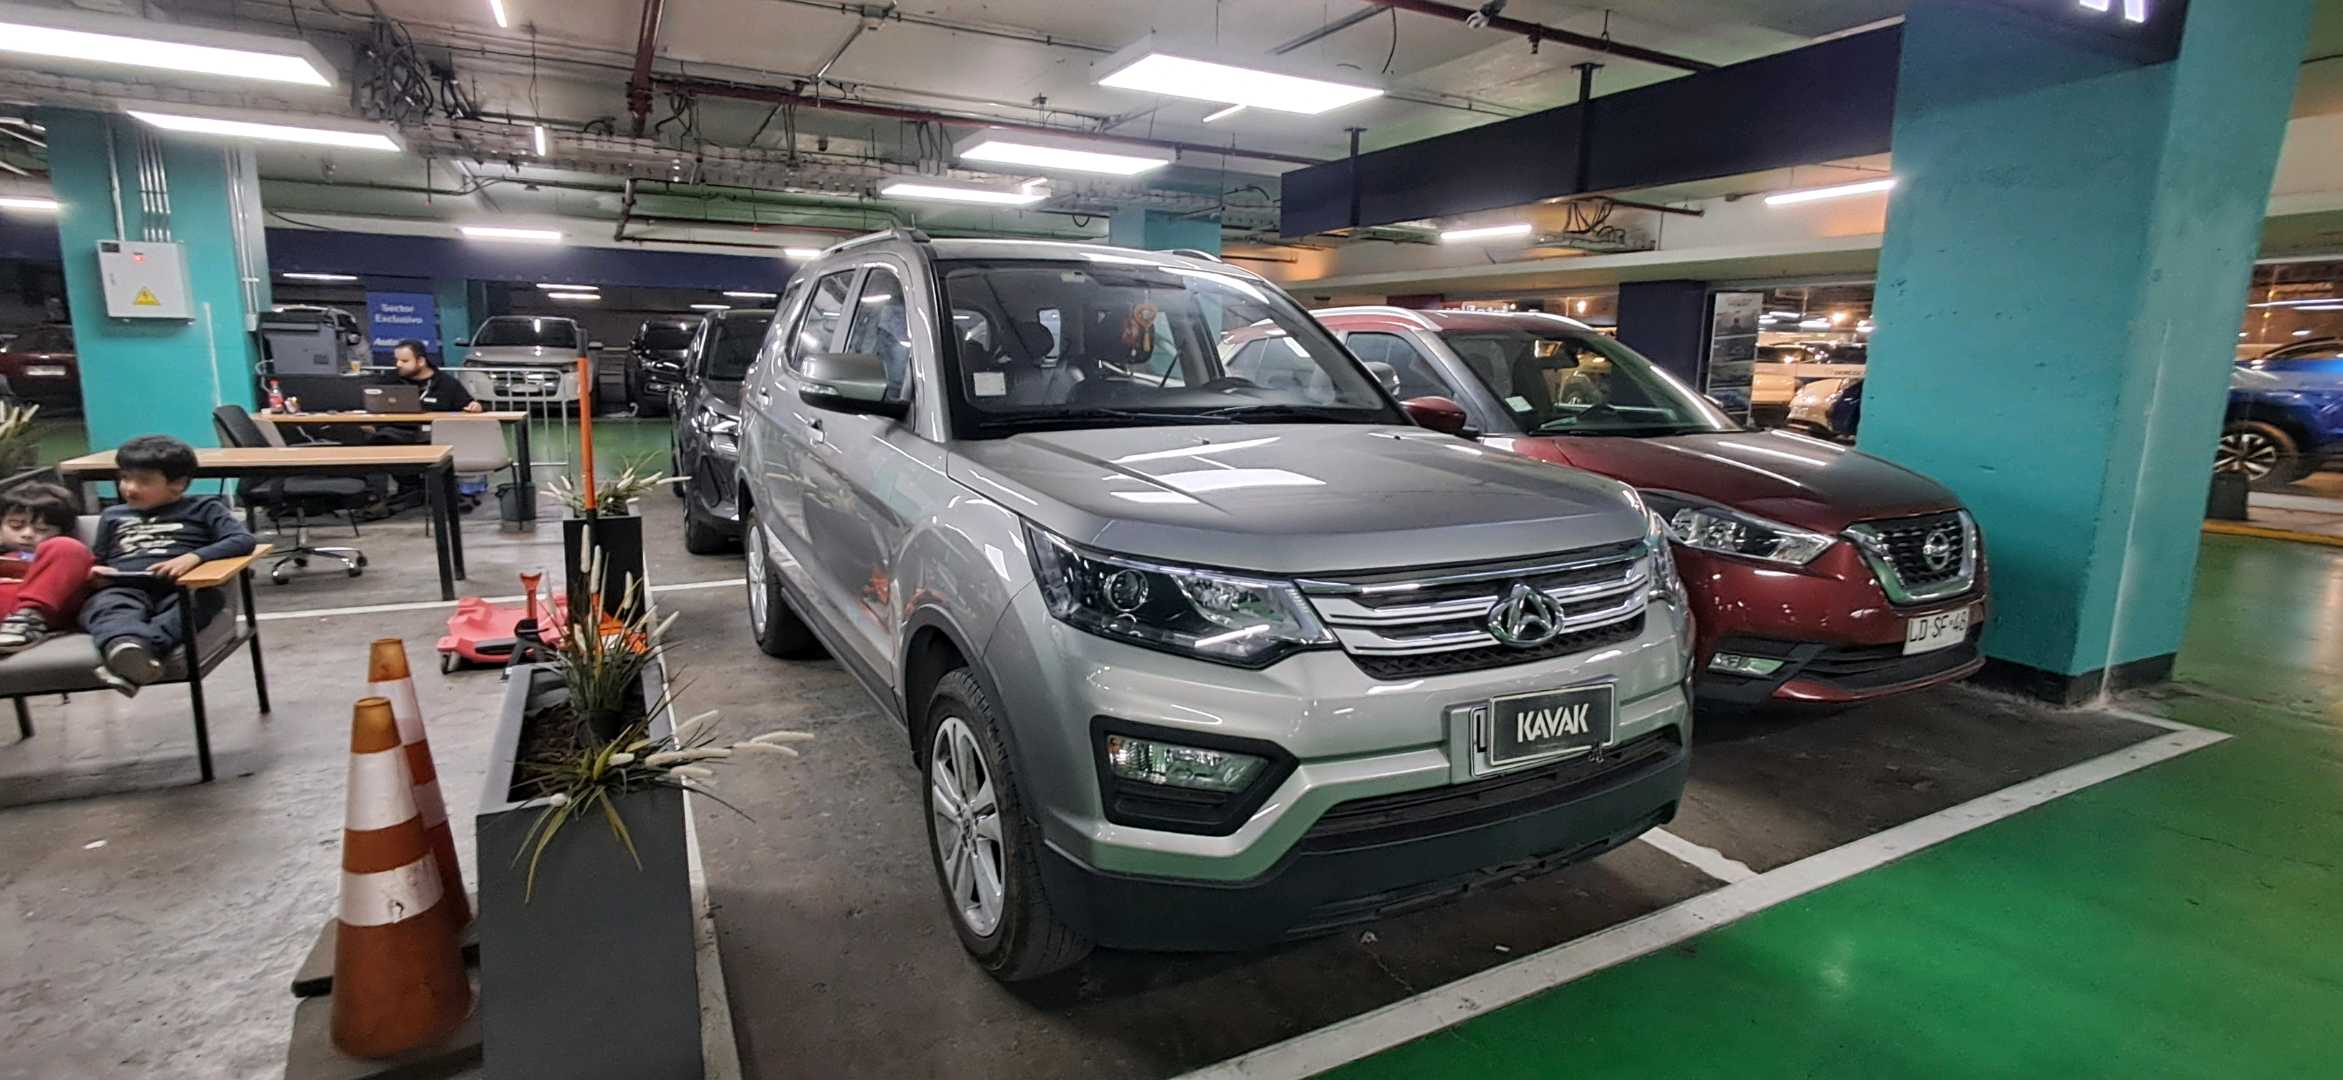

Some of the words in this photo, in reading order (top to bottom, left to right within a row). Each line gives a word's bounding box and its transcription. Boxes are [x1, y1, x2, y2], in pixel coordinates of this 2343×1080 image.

[381, 304, 414, 313] Sector
[375, 314, 424, 324] Exclusivo
[1517, 703, 1590, 743] KAVAK
